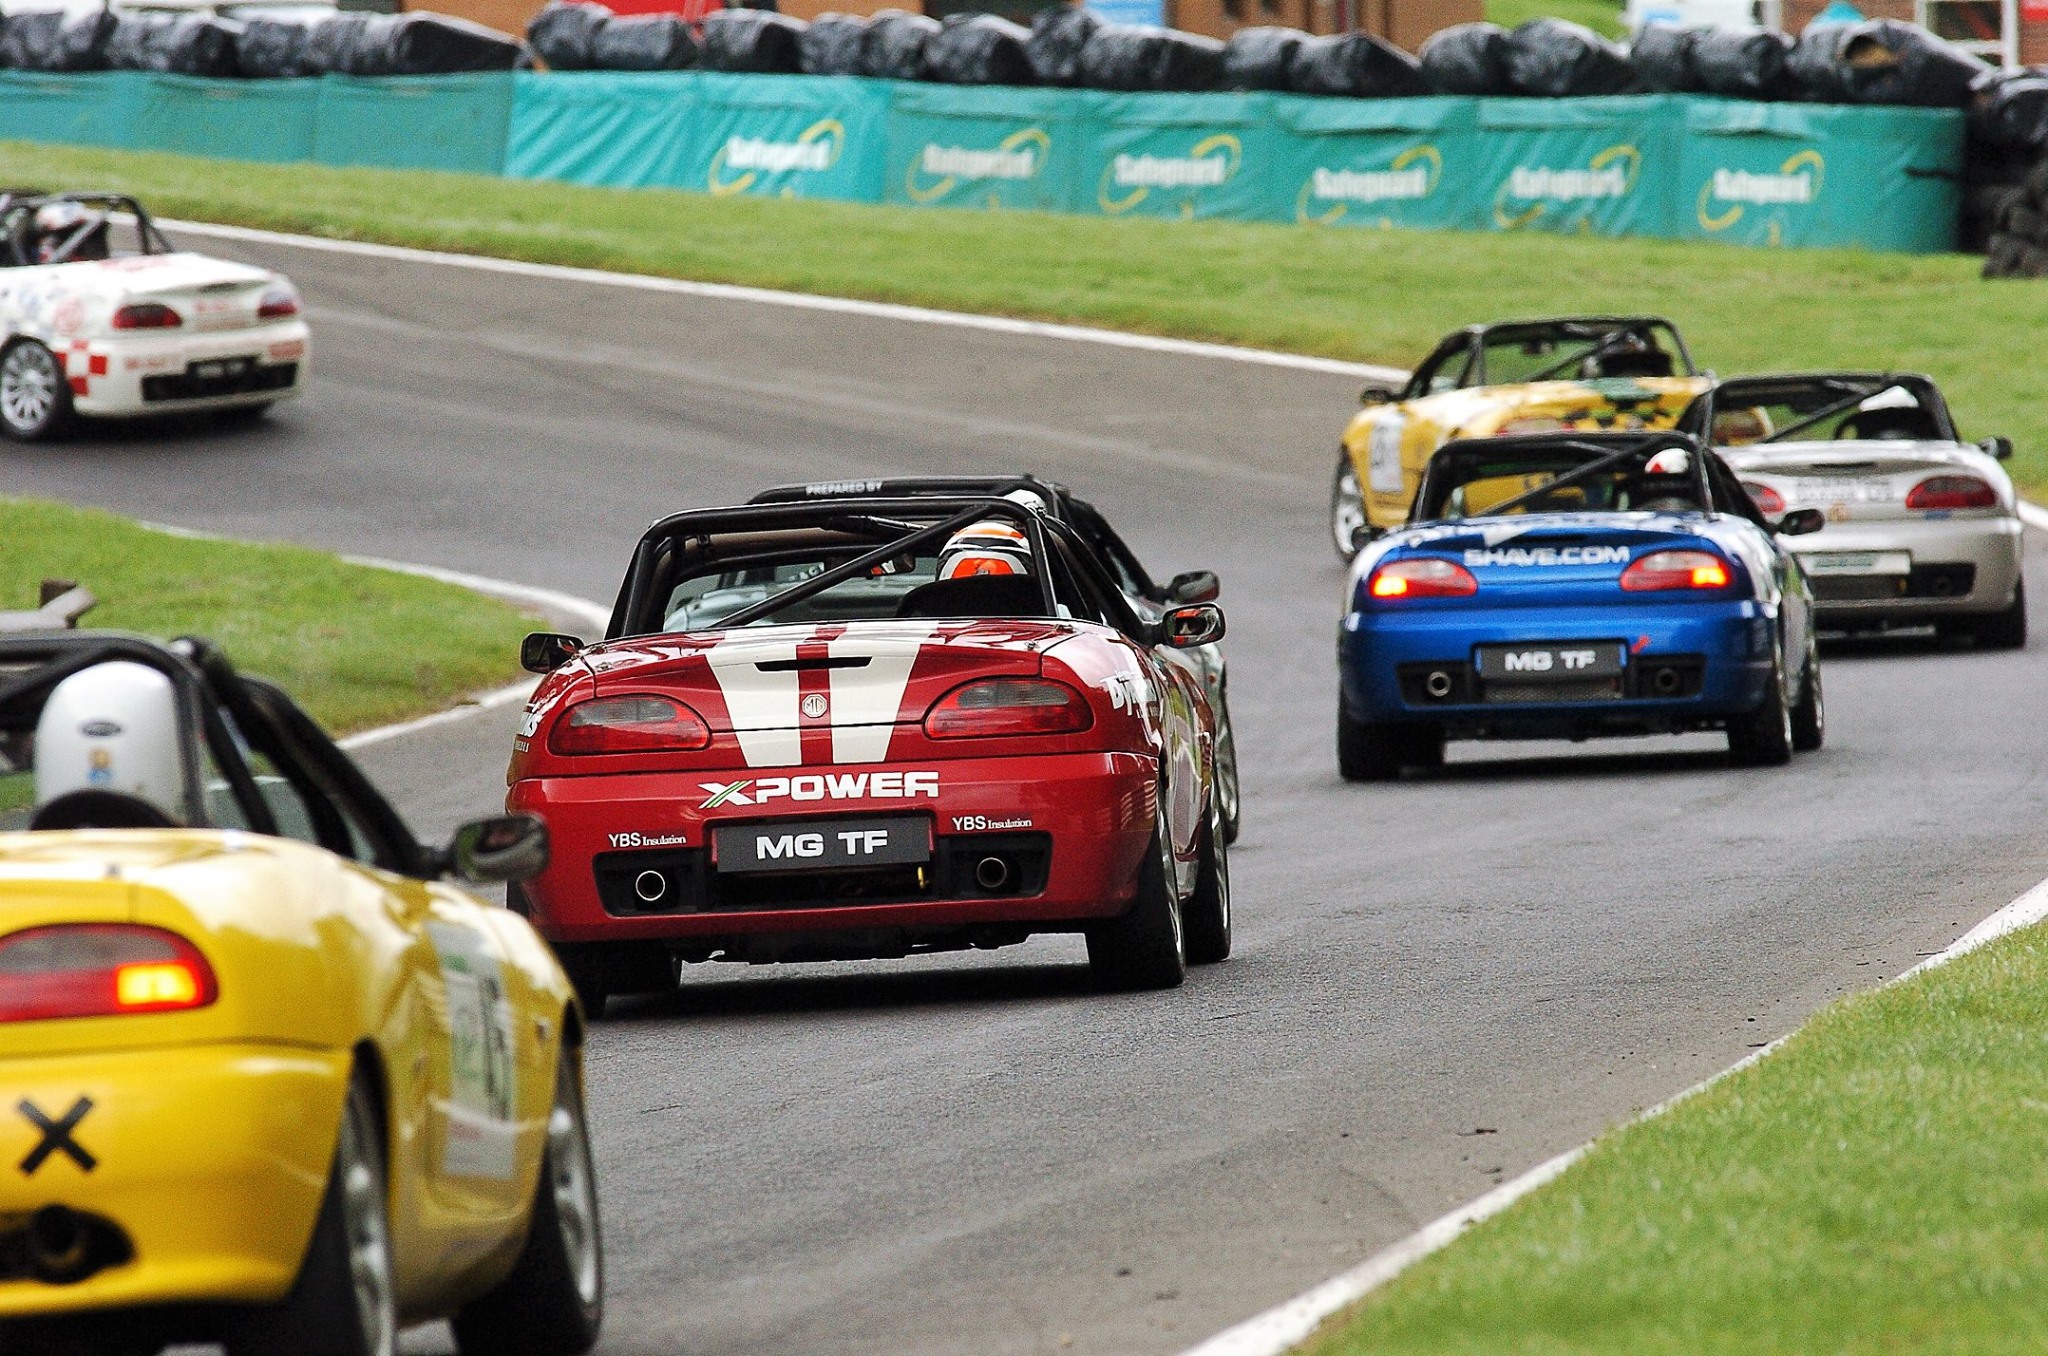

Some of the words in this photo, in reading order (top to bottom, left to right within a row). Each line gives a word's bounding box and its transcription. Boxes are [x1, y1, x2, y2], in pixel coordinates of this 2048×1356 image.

[1505, 652, 1553, 671] MG
[1560, 650, 1596, 669] TF
[698, 771, 939, 809] XPOWER
[952, 815, 986, 831] YBS
[987, 818, 1032, 830] Insulation
[608, 832, 642, 848] YBS
[642, 834, 687, 846] Insulation
[756, 833, 824, 859] MG
[837, 830, 888, 855] TF
